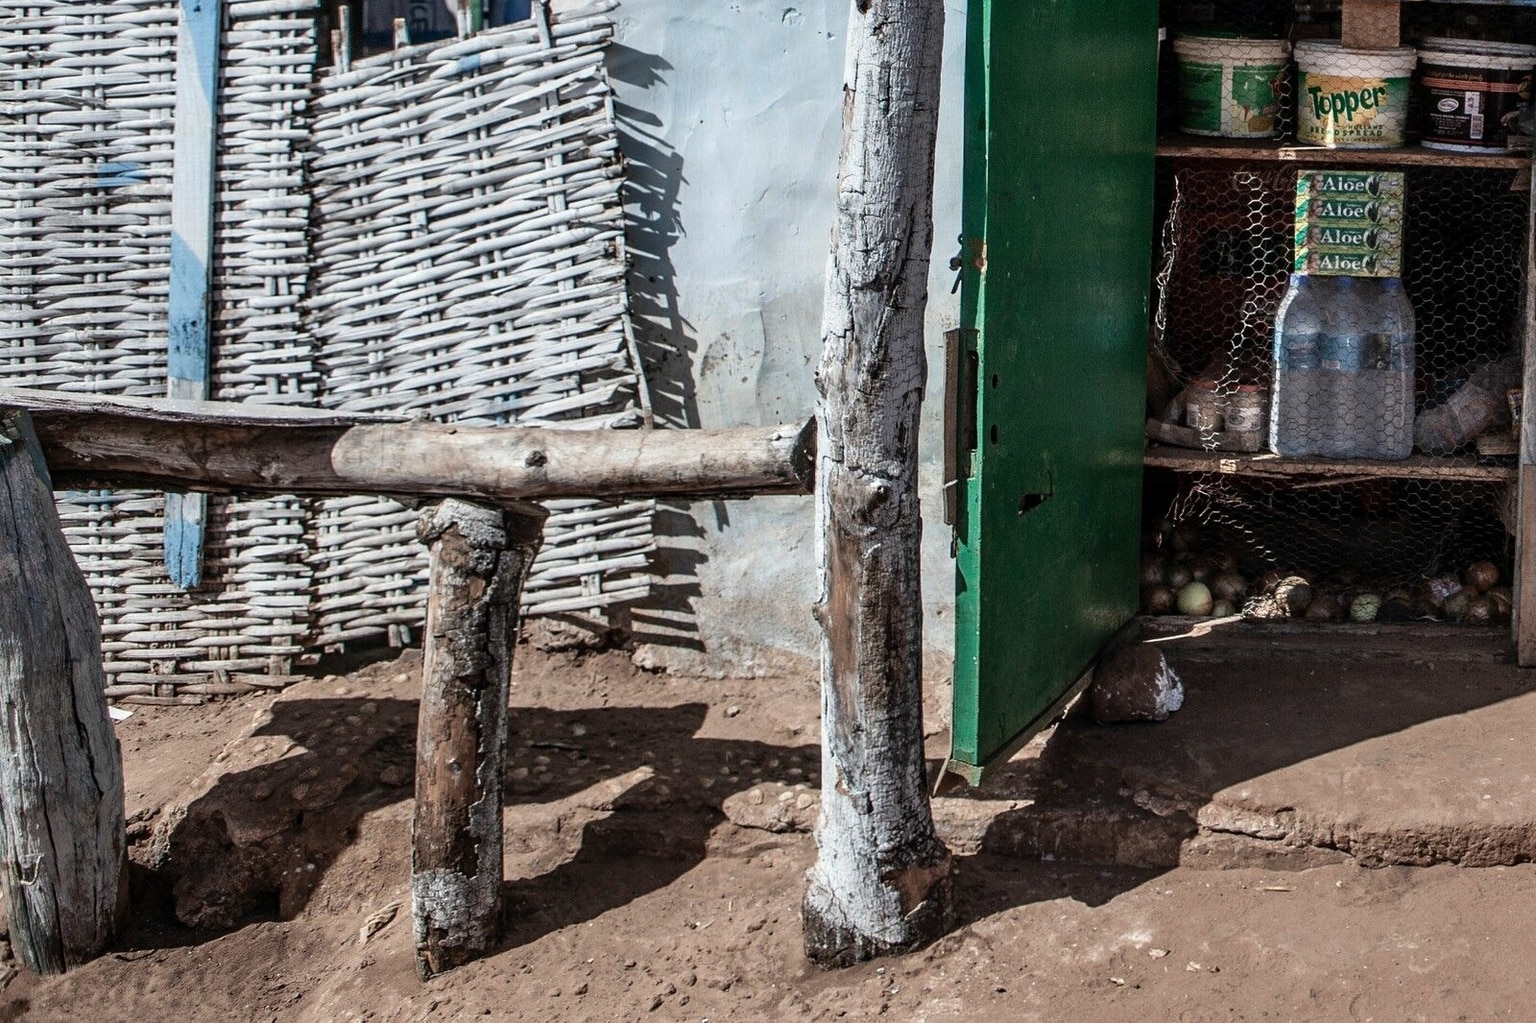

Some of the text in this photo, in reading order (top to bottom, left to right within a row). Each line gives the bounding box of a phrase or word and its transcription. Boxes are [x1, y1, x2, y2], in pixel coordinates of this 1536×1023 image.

[1308, 86, 1385, 123] Topper
[1322, 176, 1364, 191] Aloe
[1320, 201, 1363, 217] Aloe
[1319, 227, 1362, 243] Aloe
[1318, 250, 1361, 269] Aloe
